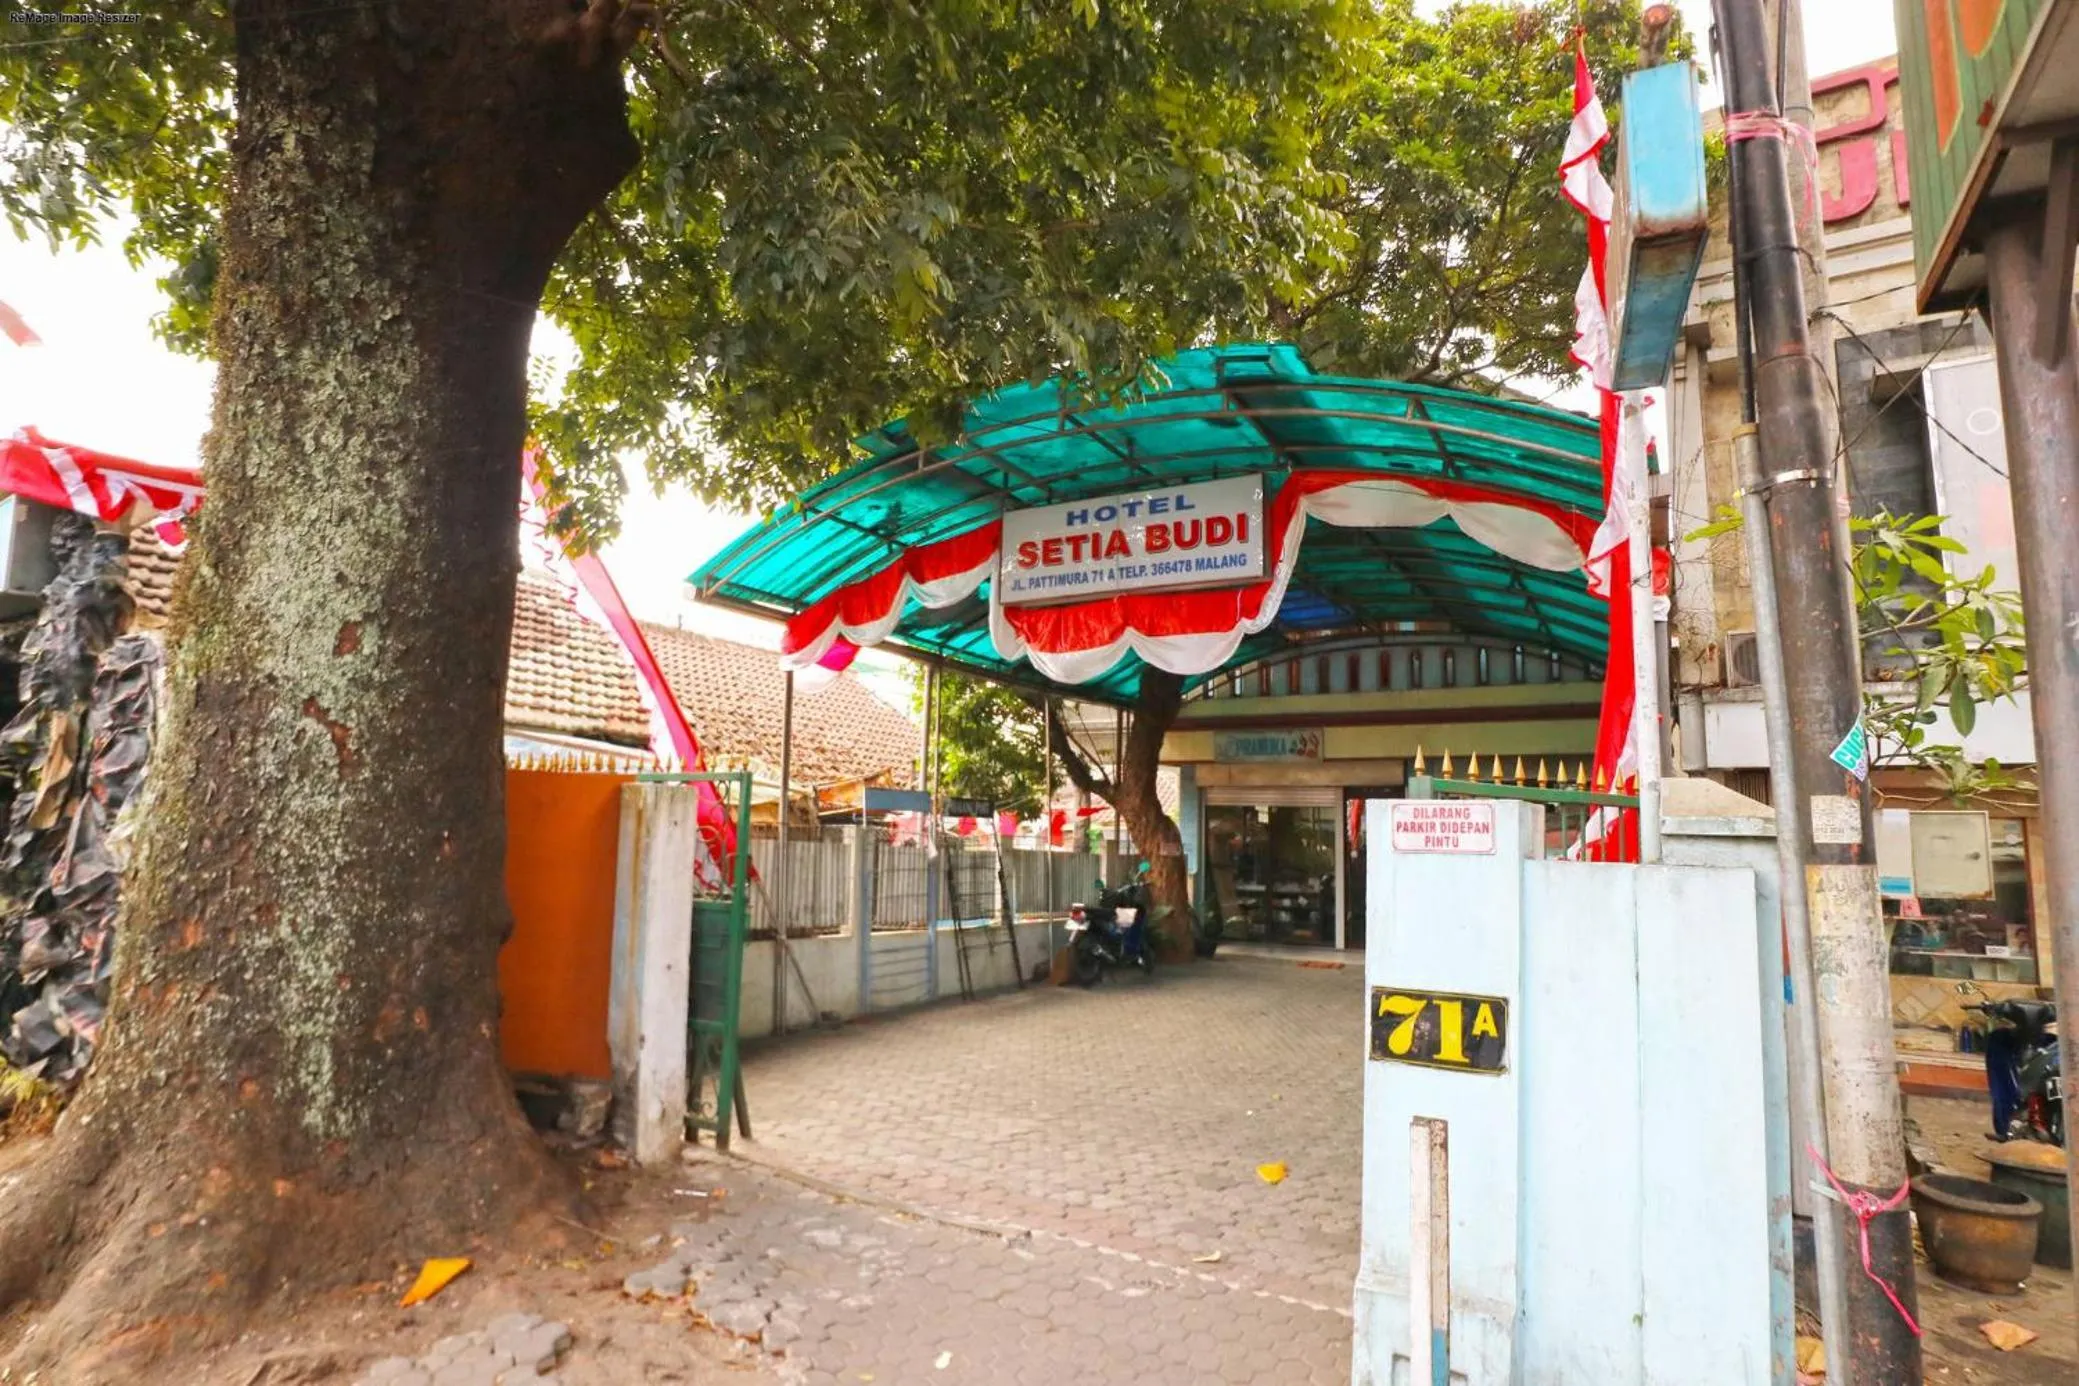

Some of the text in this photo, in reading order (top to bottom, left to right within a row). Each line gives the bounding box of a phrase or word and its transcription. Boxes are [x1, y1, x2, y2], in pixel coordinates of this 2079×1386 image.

[1066, 494, 1195, 526] HOTEL
[1017, 512, 1249, 569] SETIA BUDI
[1012, 579, 1026, 591] JL.
[1029, 572, 1089, 589] PATTIMURA
[1108, 569, 1115, 580] A
[1119, 565, 1148, 580] TELP.
[1151, 559, 1192, 576] 366478
[1195, 553, 1248, 572] MALANG
[1413, 807, 1471, 820] DILARANG
[1396, 821, 1490, 834] PARKIR DIDEPAN
[1424, 835, 1460, 848] PINTU
